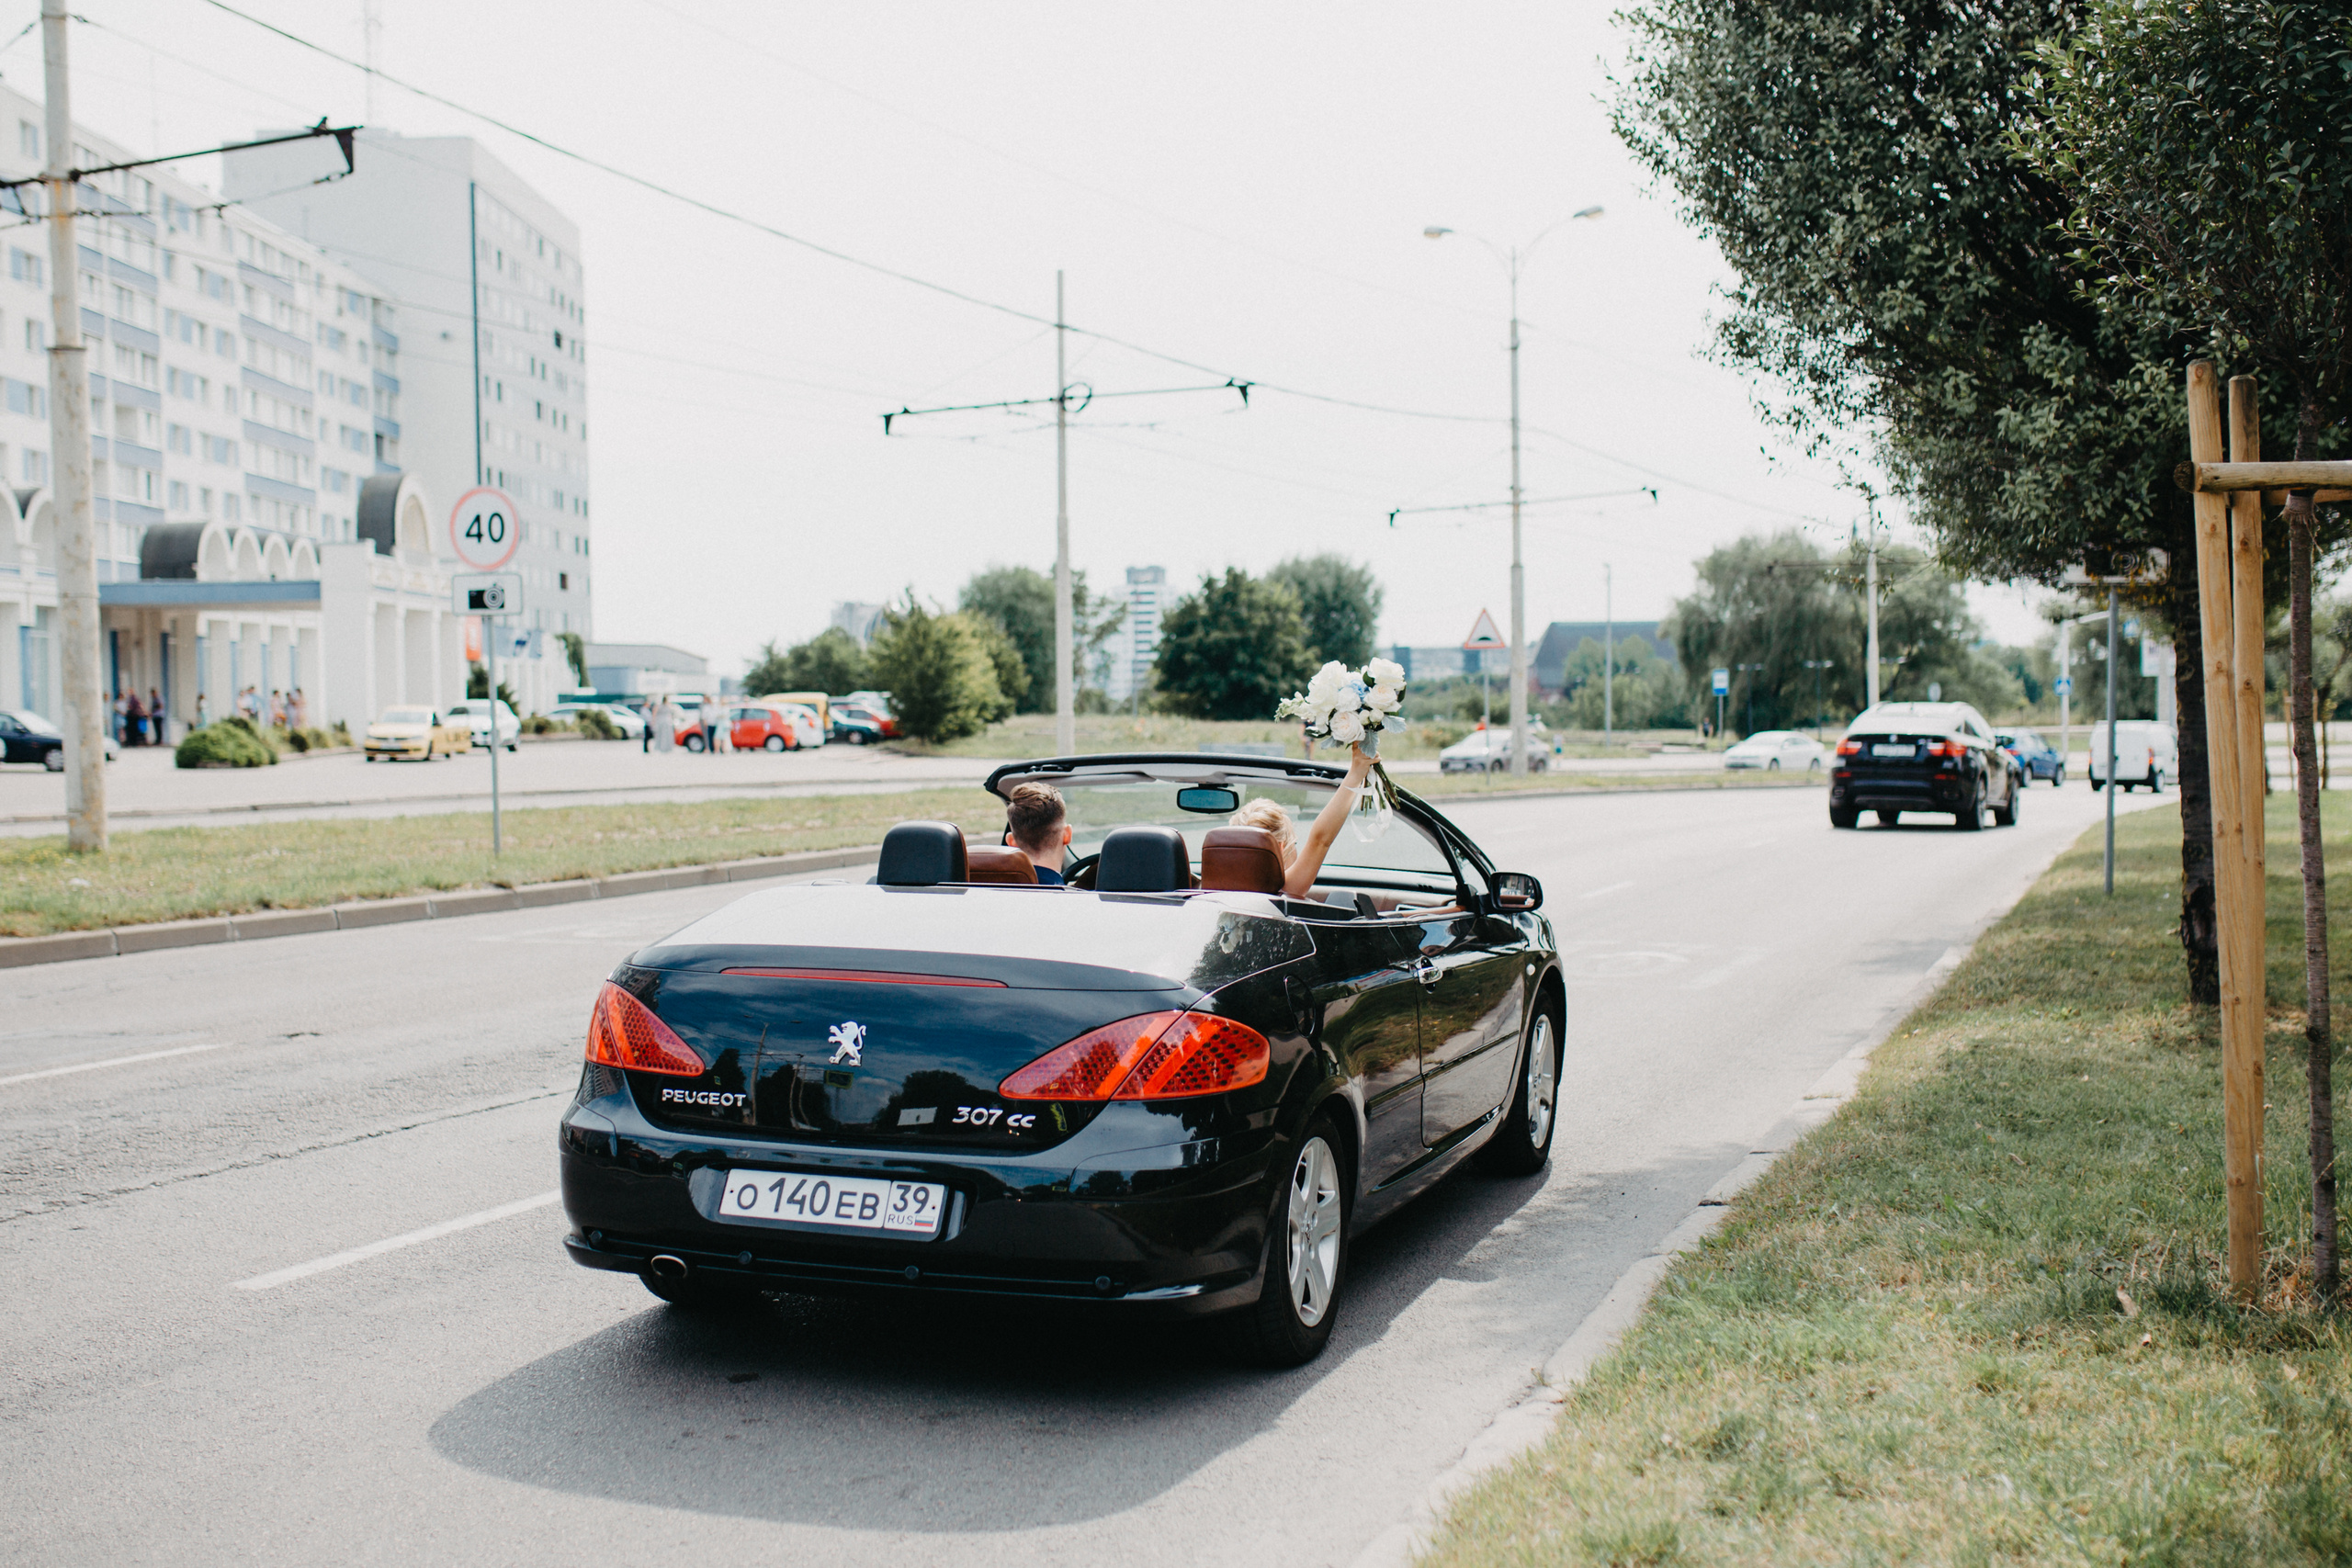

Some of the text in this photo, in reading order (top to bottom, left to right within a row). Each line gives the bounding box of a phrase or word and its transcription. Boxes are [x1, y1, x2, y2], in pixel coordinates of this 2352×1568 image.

[465, 513, 504, 543] 40
[662, 1088, 746, 1107] PEUGEOT
[952, 1106, 1003, 1125] 307
[892, 1184, 930, 1213] 39
[888, 1213, 913, 1225] RUS
